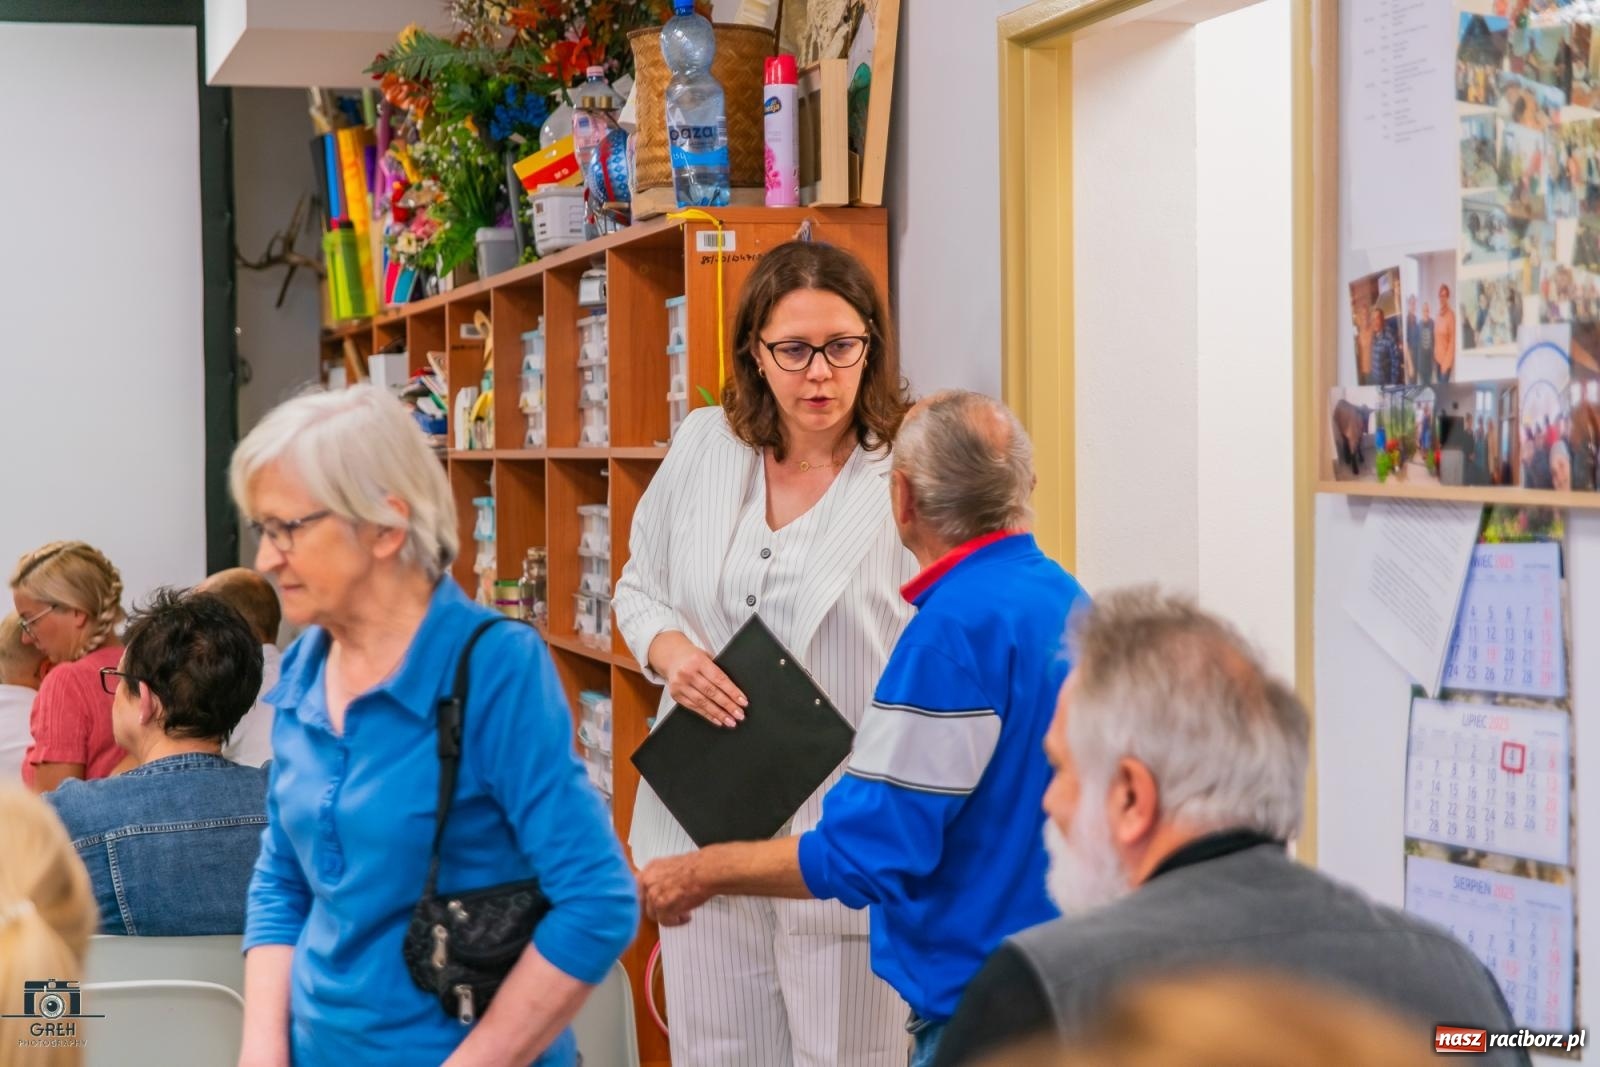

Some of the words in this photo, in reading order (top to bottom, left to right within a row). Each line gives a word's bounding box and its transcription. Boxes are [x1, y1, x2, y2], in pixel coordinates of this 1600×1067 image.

[669, 126, 714, 141] oaza
[1487, 626, 1497, 641] 12
[1505, 628, 1515, 642] 13
[1523, 629, 1533, 643] 14
[1504, 648, 1515, 663] 20
[1466, 665, 1477, 680] 25
[1485, 666, 1495, 682] 26
[1503, 669, 1514, 683] 27
[1461, 713, 1487, 729] LIPIEC
[1486, 768, 1497, 783] 10
[1431, 780, 1441, 793] 14
[1449, 782, 1459, 796] 15
[1467, 785, 1477, 800] 16
[1486, 788, 1497, 804] 17
[1429, 799, 1439, 813] 21
[1447, 802, 1457, 816] 22
[1466, 805, 1477, 820] 23
[1485, 808, 1496, 822] 24
[1503, 811, 1515, 827] 25
[1428, 819, 1440, 833] 28
[1465, 825, 1476, 840] 30
[1485, 828, 1495, 842] 31
